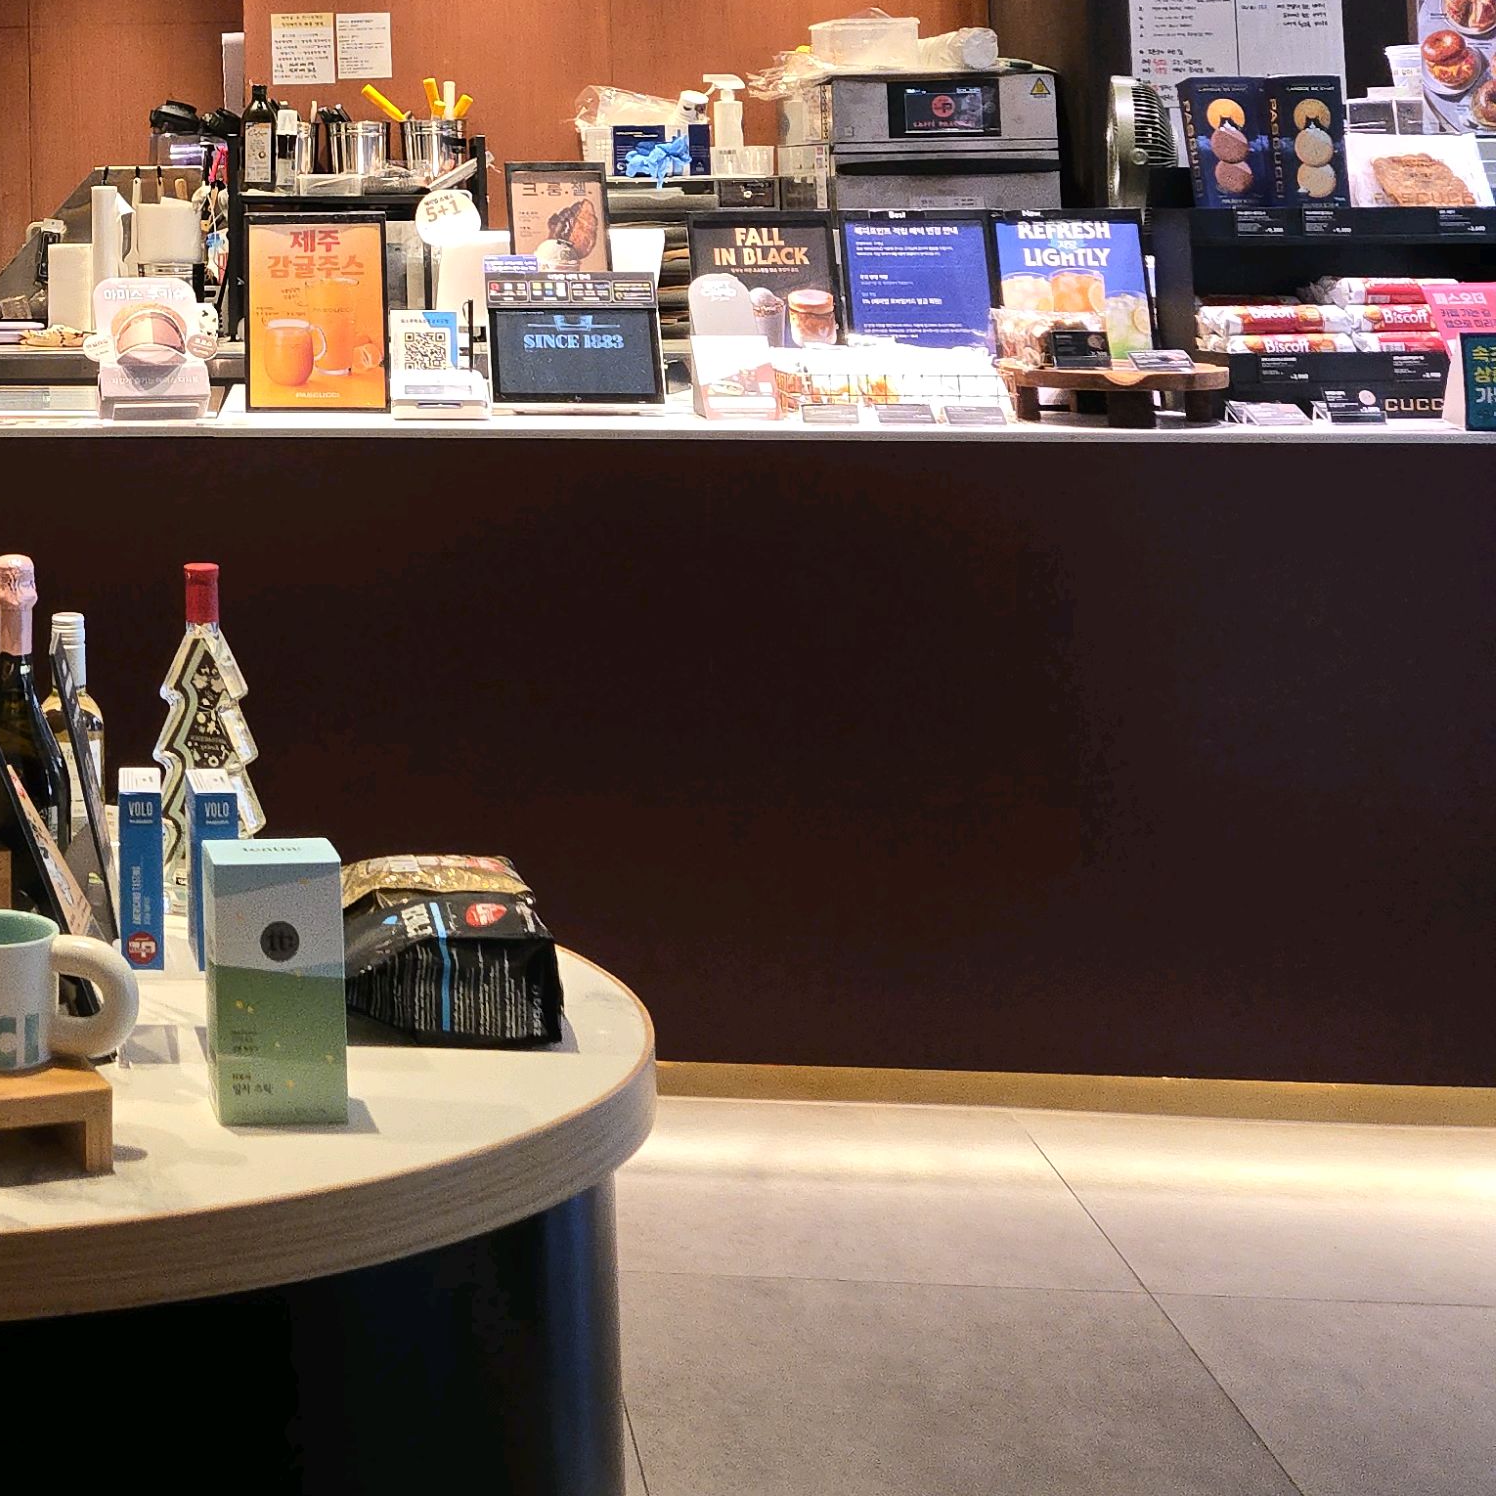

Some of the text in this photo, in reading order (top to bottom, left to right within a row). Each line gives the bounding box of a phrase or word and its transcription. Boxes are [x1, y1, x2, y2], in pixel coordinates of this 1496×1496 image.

[735, 228, 785, 246] FALL
[1017, 221, 1111, 239] REFRESH
[290, 230, 340, 252] 제주
[714, 247, 809, 266] IN BLACK
[1023, 248, 1111, 267] LIGHTLY
[267, 256, 364, 278] 감귤주스
[1384, 308, 1428, 324] Biscoff
[524, 334, 624, 349] SINCE 1883
[1263, 339, 1311, 353] Biscoff
[128, 801, 153, 817] VOLO
[204, 802, 229, 817] VOLO
